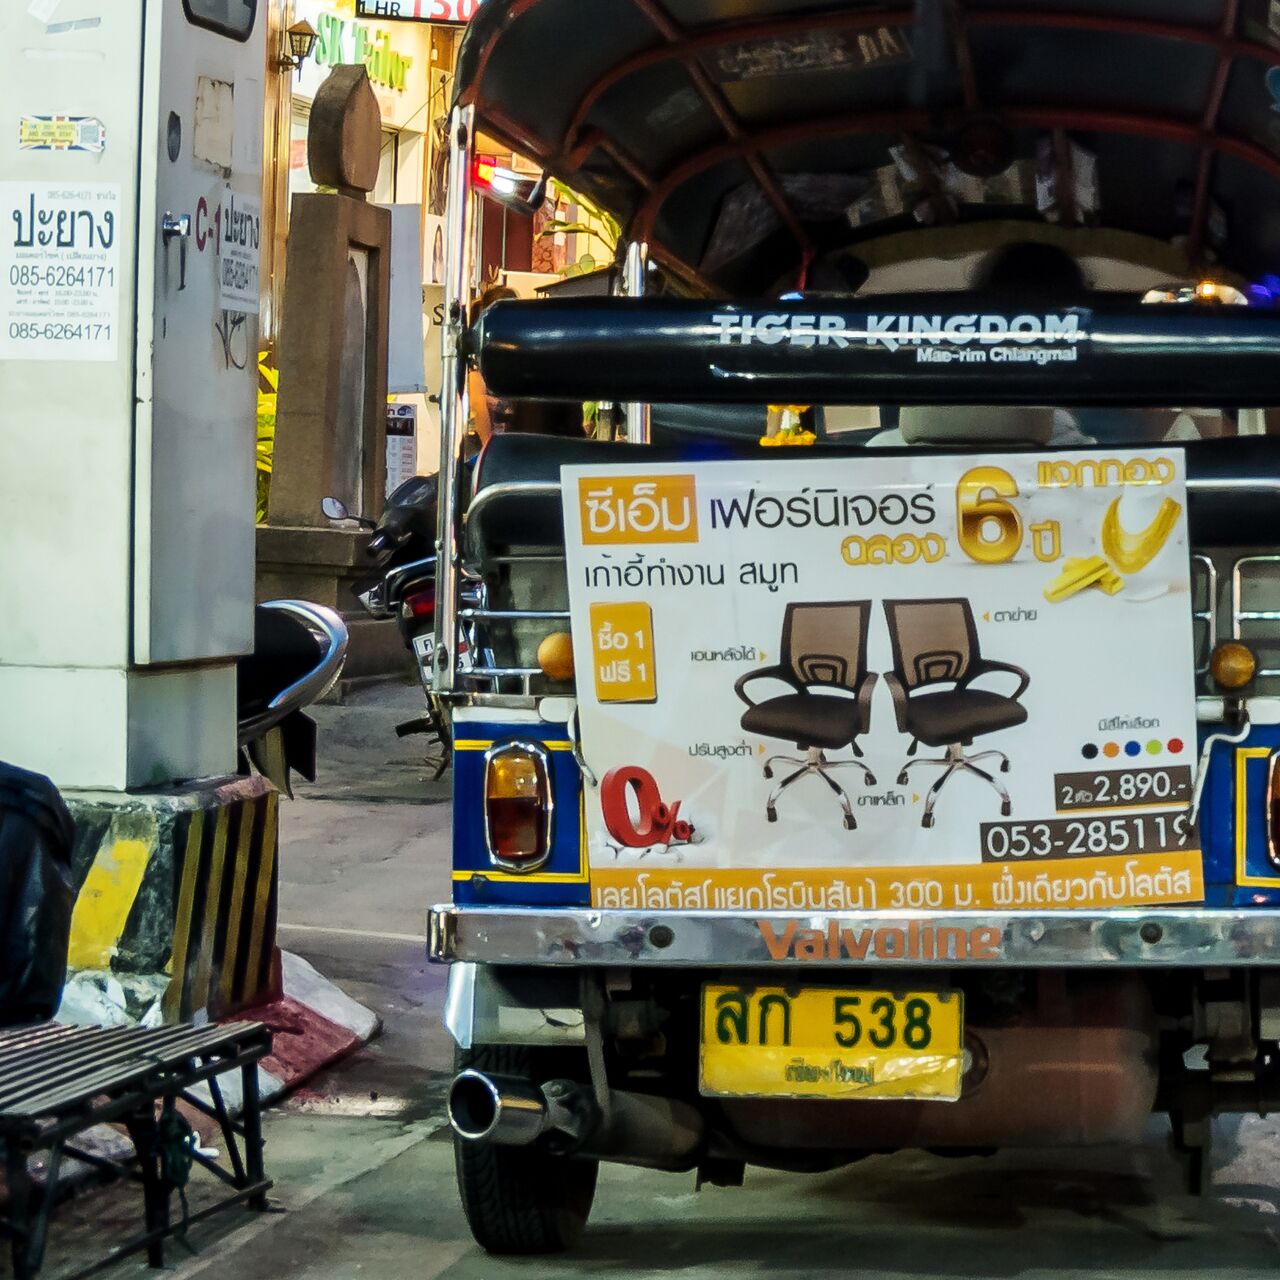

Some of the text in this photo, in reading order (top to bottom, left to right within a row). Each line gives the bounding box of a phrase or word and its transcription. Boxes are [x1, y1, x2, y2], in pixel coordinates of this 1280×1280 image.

[375, 1, 401, 17] HR
[12, 193, 114, 249] ปะยาง
[9, 265, 114, 287] 085-6264171
[9, 322, 111, 341] 085-6264171
[712, 314, 1080, 352] TIGER KINGDOM
[1037, 457, 1175, 488] แจกทอง
[585, 482, 938, 533] ซีเอ็ม เฟอร์นิเจอร์
[956, 465, 1023, 564] 6
[585, 552, 799, 592] เก้าอี้ทำงาน สมูท
[634, 630, 644, 649] 1
[599, 660, 648, 683] ฟรี 1
[890, 879, 945, 909] 300
[757, 921, 1001, 961] Valvoline
[834, 996, 932, 1050] 538
